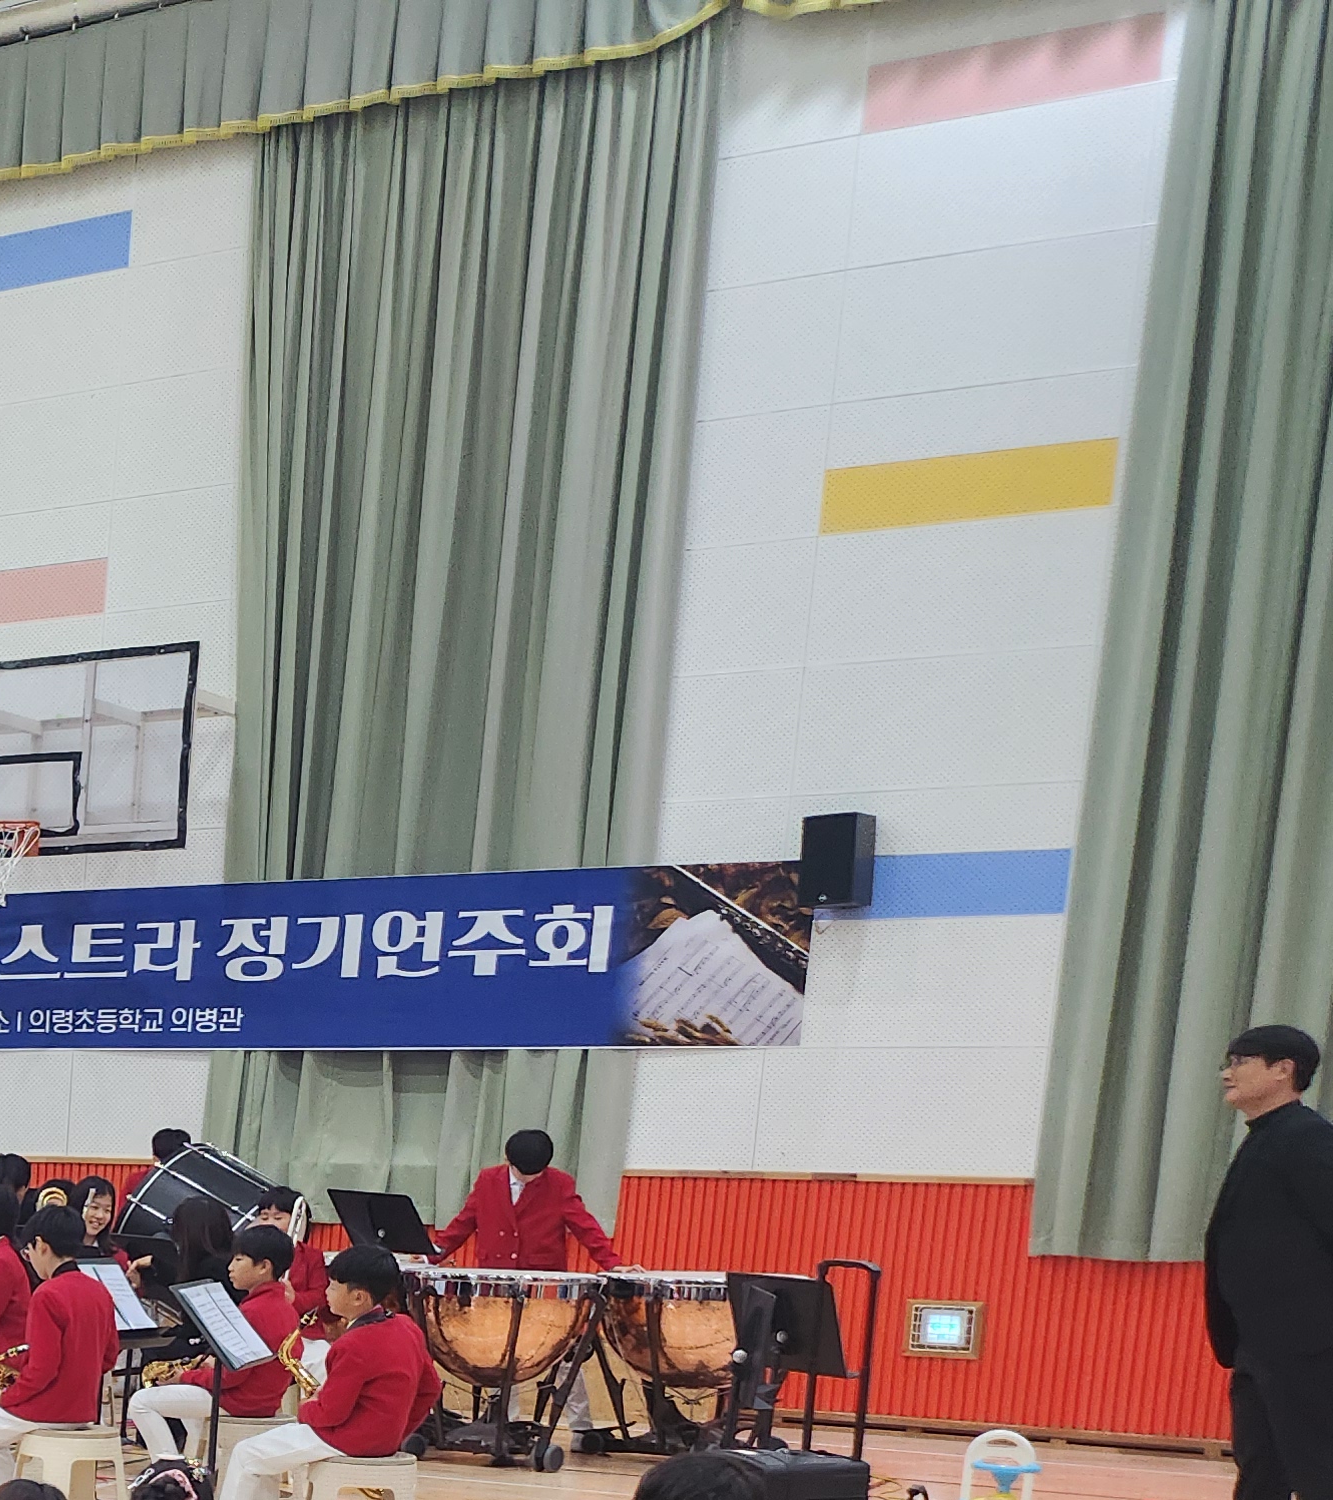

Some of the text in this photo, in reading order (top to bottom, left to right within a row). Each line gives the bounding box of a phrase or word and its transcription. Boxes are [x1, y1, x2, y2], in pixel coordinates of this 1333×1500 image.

[216, 905, 614, 981] 정기연주회
[27, 1007, 165, 1035] 의령초등학교
[170, 1006, 245, 1034] 의병관
